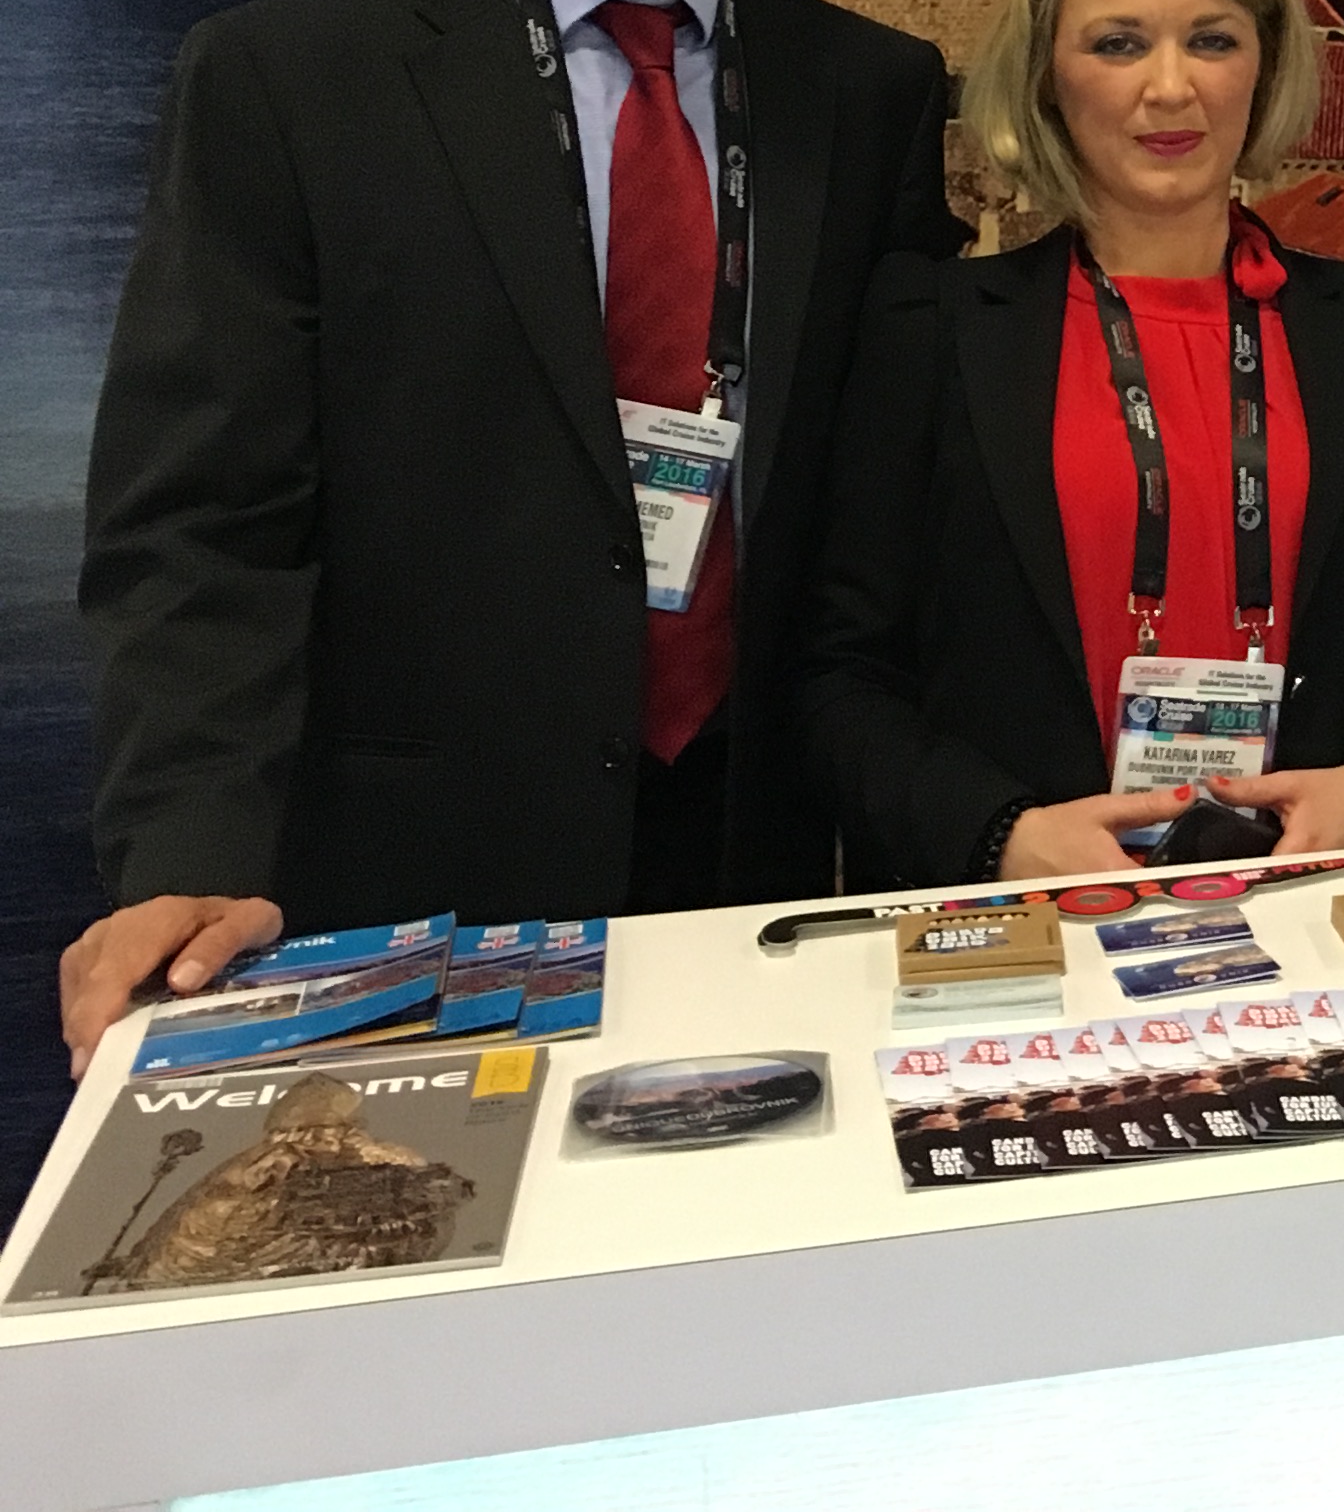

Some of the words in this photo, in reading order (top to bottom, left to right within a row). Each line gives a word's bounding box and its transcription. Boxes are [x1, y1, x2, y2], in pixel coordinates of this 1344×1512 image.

[654, 463, 706, 485] 2016
[1130, 665, 1186, 678] ORACLE
[1211, 711, 1260, 728] 2016
[1143, 745, 1199, 764] KATARINA
[873, 902, 943, 918] PAST
[132, 1069, 470, 1114] Welme
